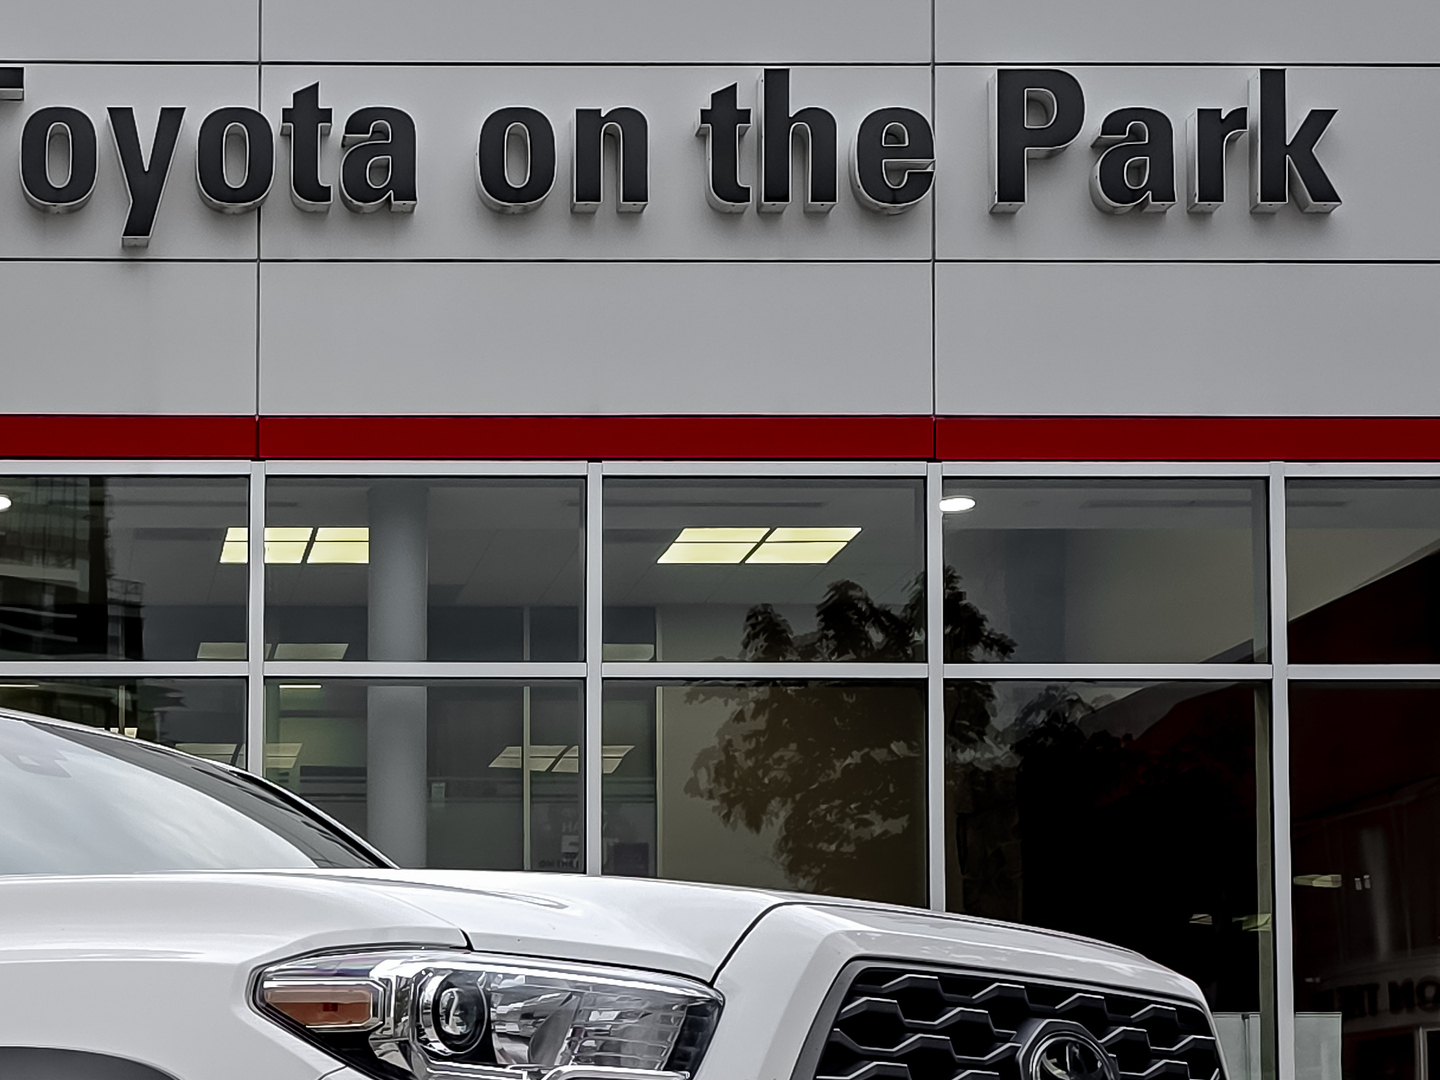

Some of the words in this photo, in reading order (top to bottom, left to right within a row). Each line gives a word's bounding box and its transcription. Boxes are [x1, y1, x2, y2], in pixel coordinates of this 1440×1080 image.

[476, 106, 651, 213] on
[696, 67, 936, 213] the
[988, 67, 1341, 213] Park
